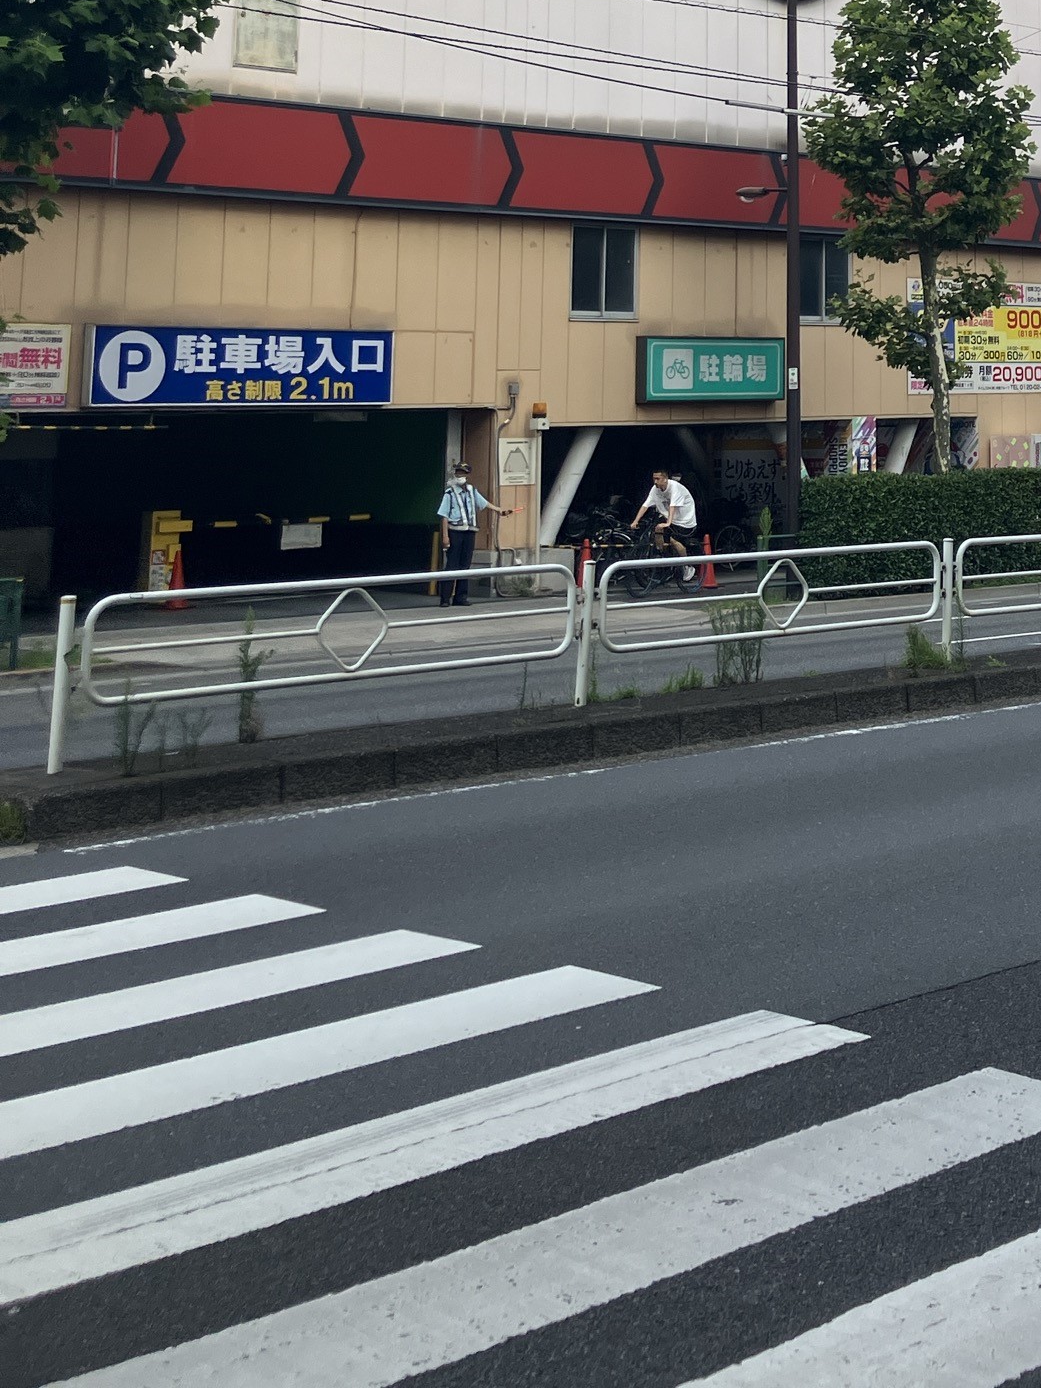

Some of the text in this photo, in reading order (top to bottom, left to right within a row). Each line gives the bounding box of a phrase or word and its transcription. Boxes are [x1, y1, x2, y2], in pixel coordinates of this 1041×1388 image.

[173, 334, 385, 375] 駐車場入口
[957, 335, 1000, 345] 初期30分無料
[117, 342, 152, 390] P
[699, 354, 767, 382] 駐輪場
[205, 376, 354, 401] 高さ制限 2.1m
[839, 444, 848, 475] ENJOY
